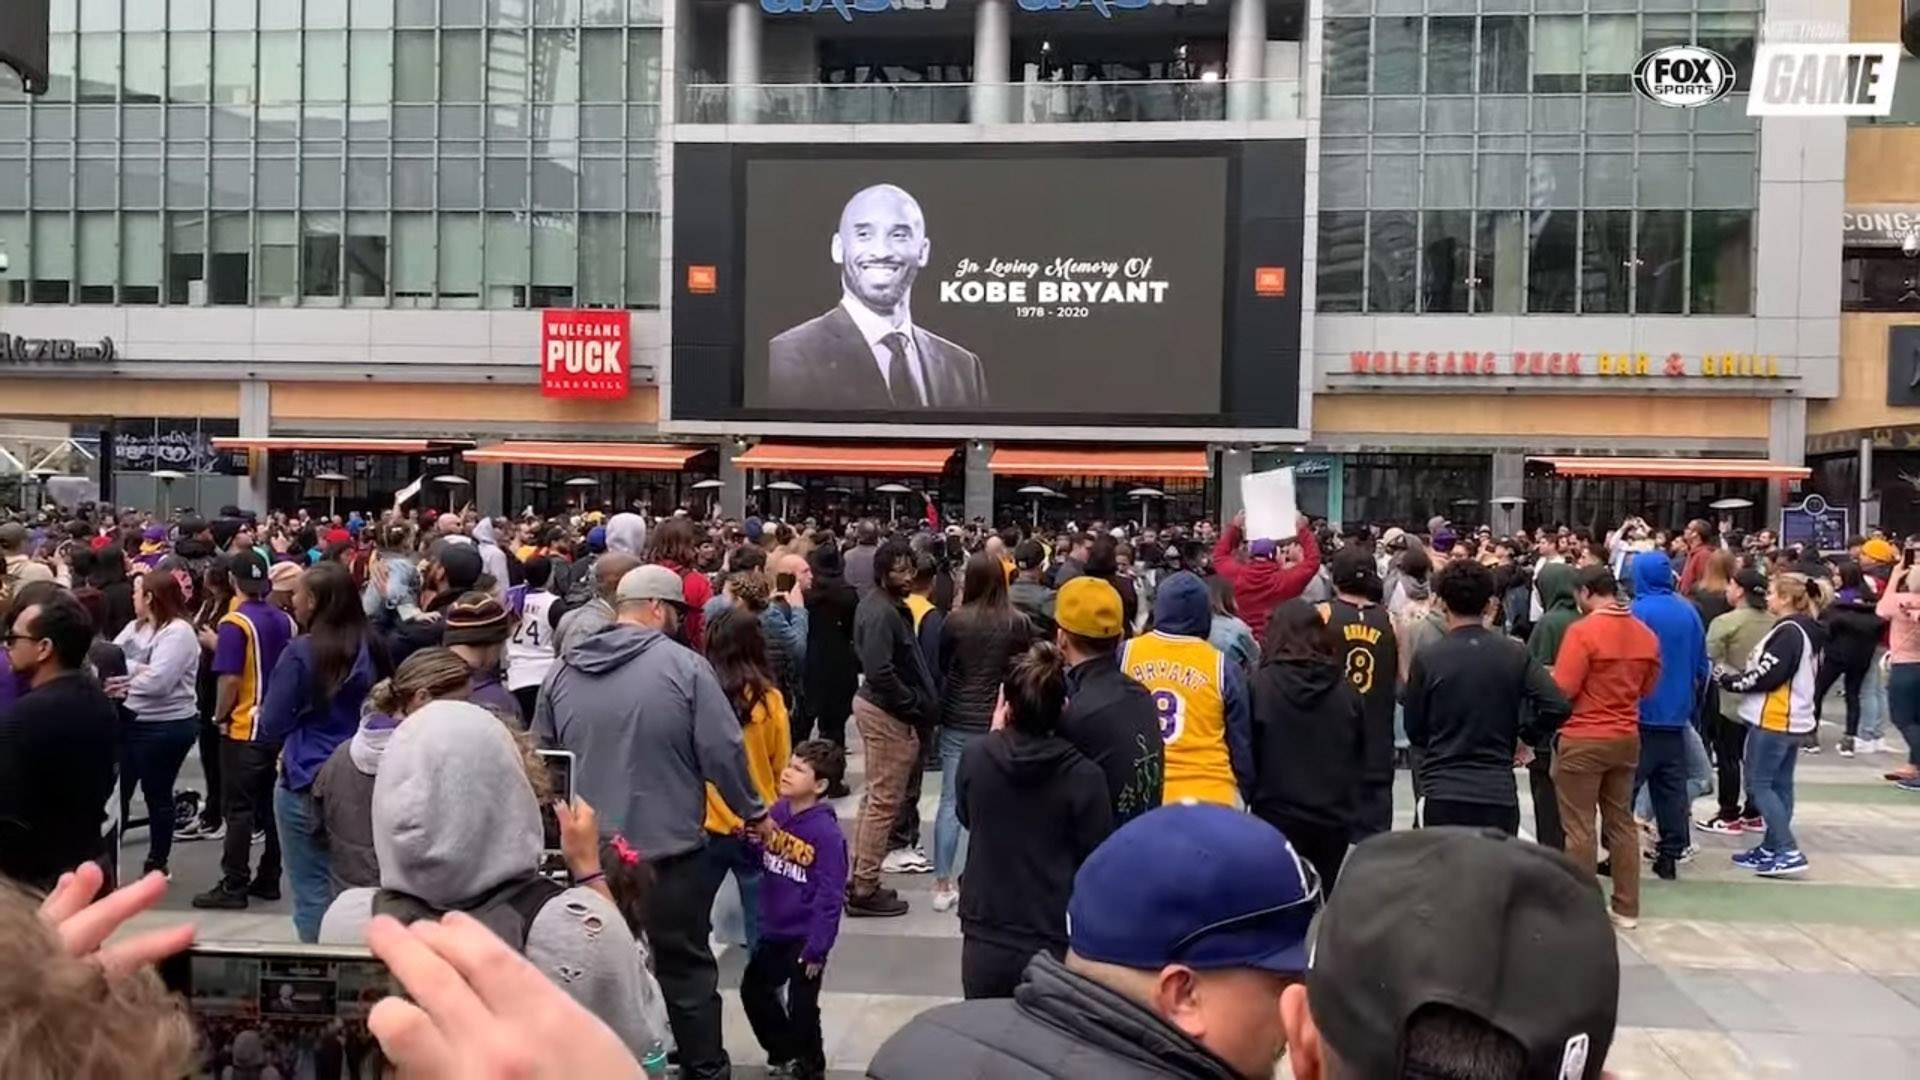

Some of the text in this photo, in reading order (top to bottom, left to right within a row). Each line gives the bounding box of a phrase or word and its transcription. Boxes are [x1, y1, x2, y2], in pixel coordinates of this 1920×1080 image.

[955, 257, 1152, 281] In Loving Memory Of
[940, 281, 1169, 303] KOBE BRYANT
[1016, 306, 1045, 318] 1978
[1057, 306, 1089, 318] 2020
[547, 322, 621, 337] WOLFGANG
[547, 340, 622, 374] PUCK
[1350, 350, 1496, 376] WOLFGANG
[1514, 351, 1581, 376] PUCK
[1598, 351, 1650, 377] BAR
[512, 620, 540, 646] 24
[1132, 661, 1208, 691] BRYANT
[1344, 646, 1375, 694] 8
